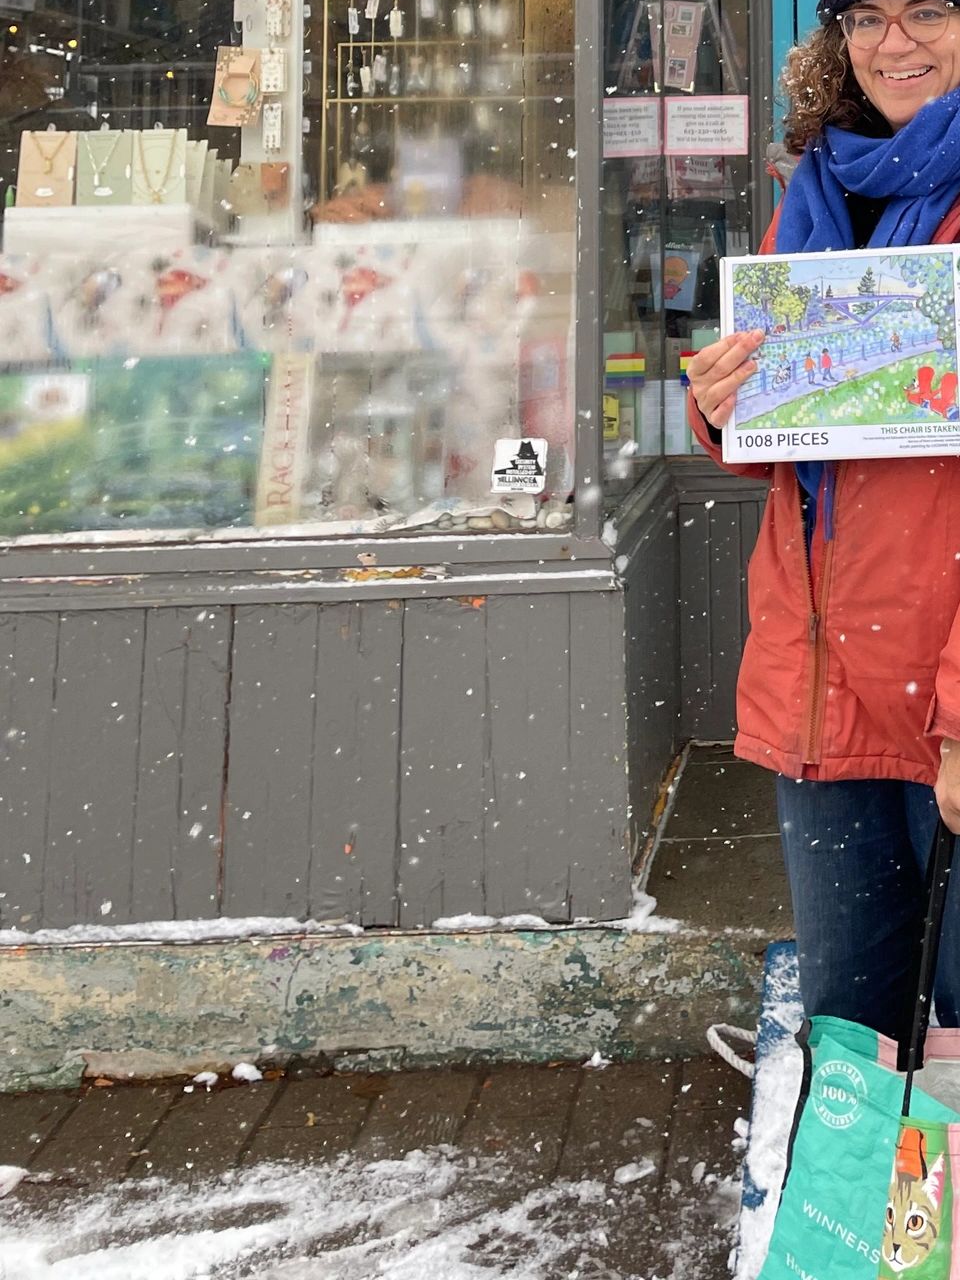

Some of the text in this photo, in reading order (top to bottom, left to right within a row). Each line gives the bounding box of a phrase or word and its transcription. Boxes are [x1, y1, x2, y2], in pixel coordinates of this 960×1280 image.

[880, 427, 898, 435] THIS
[899, 426, 923, 434] CHAIR
[736, 432, 829, 448] 1008 PIECES
[822, 1085, 857, 1105] 100%
[803, 1199, 881, 1264] WINNERS
